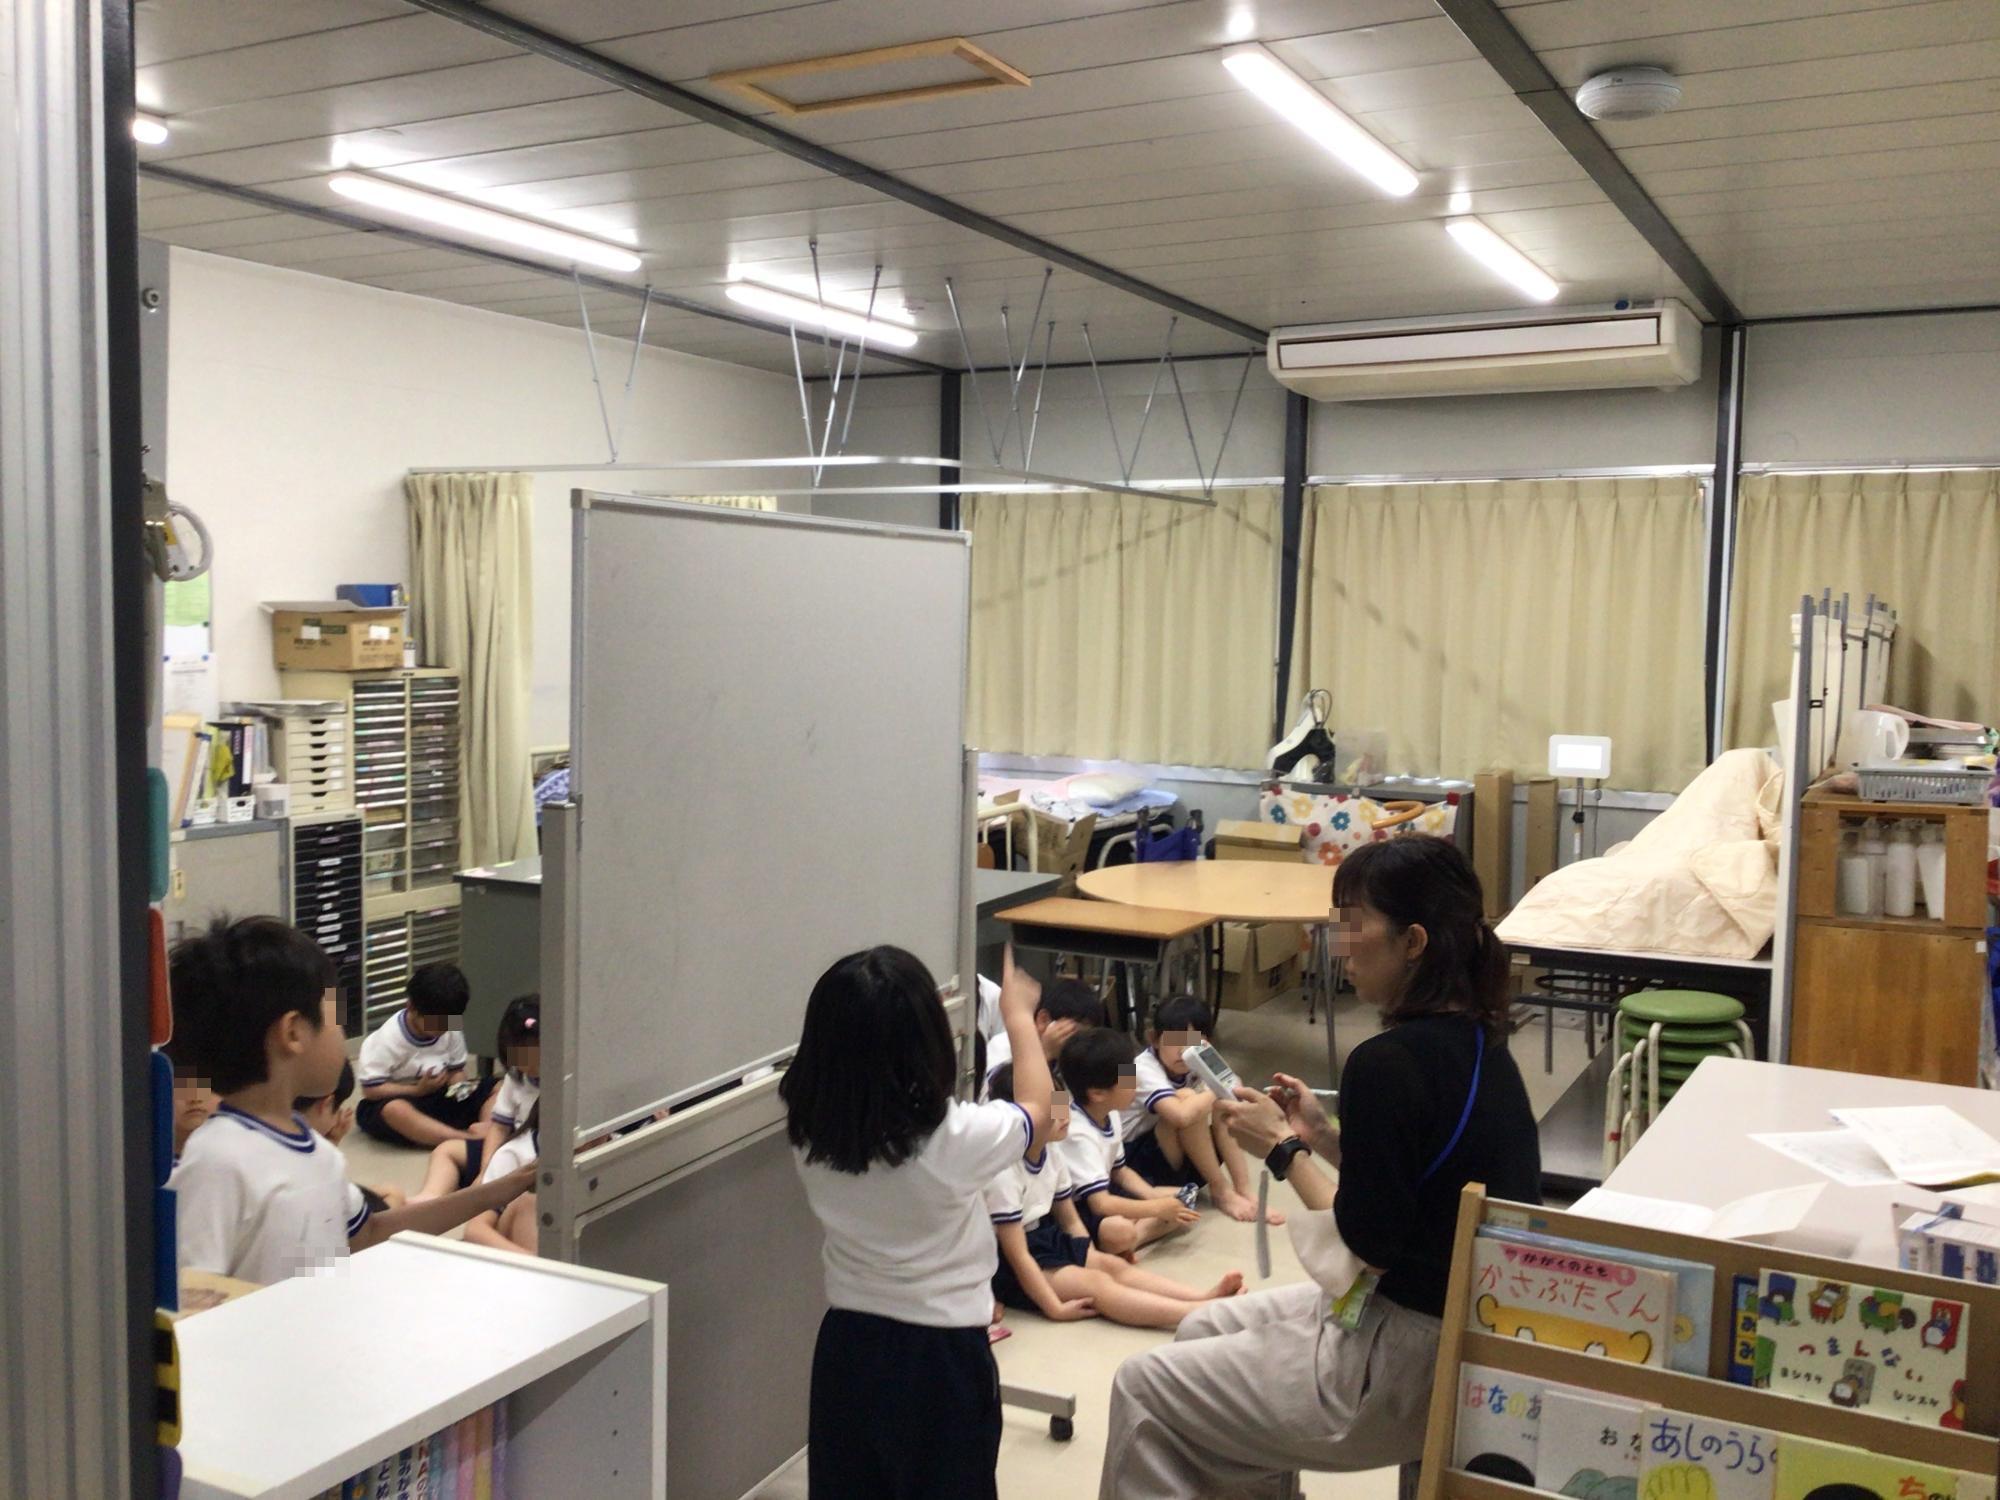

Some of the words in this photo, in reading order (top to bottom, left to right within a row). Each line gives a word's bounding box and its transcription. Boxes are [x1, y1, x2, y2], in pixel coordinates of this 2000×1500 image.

[1523, 1251, 1609, 1277] かがくのとも
[1478, 1264, 1660, 1323] かさぶたくん
